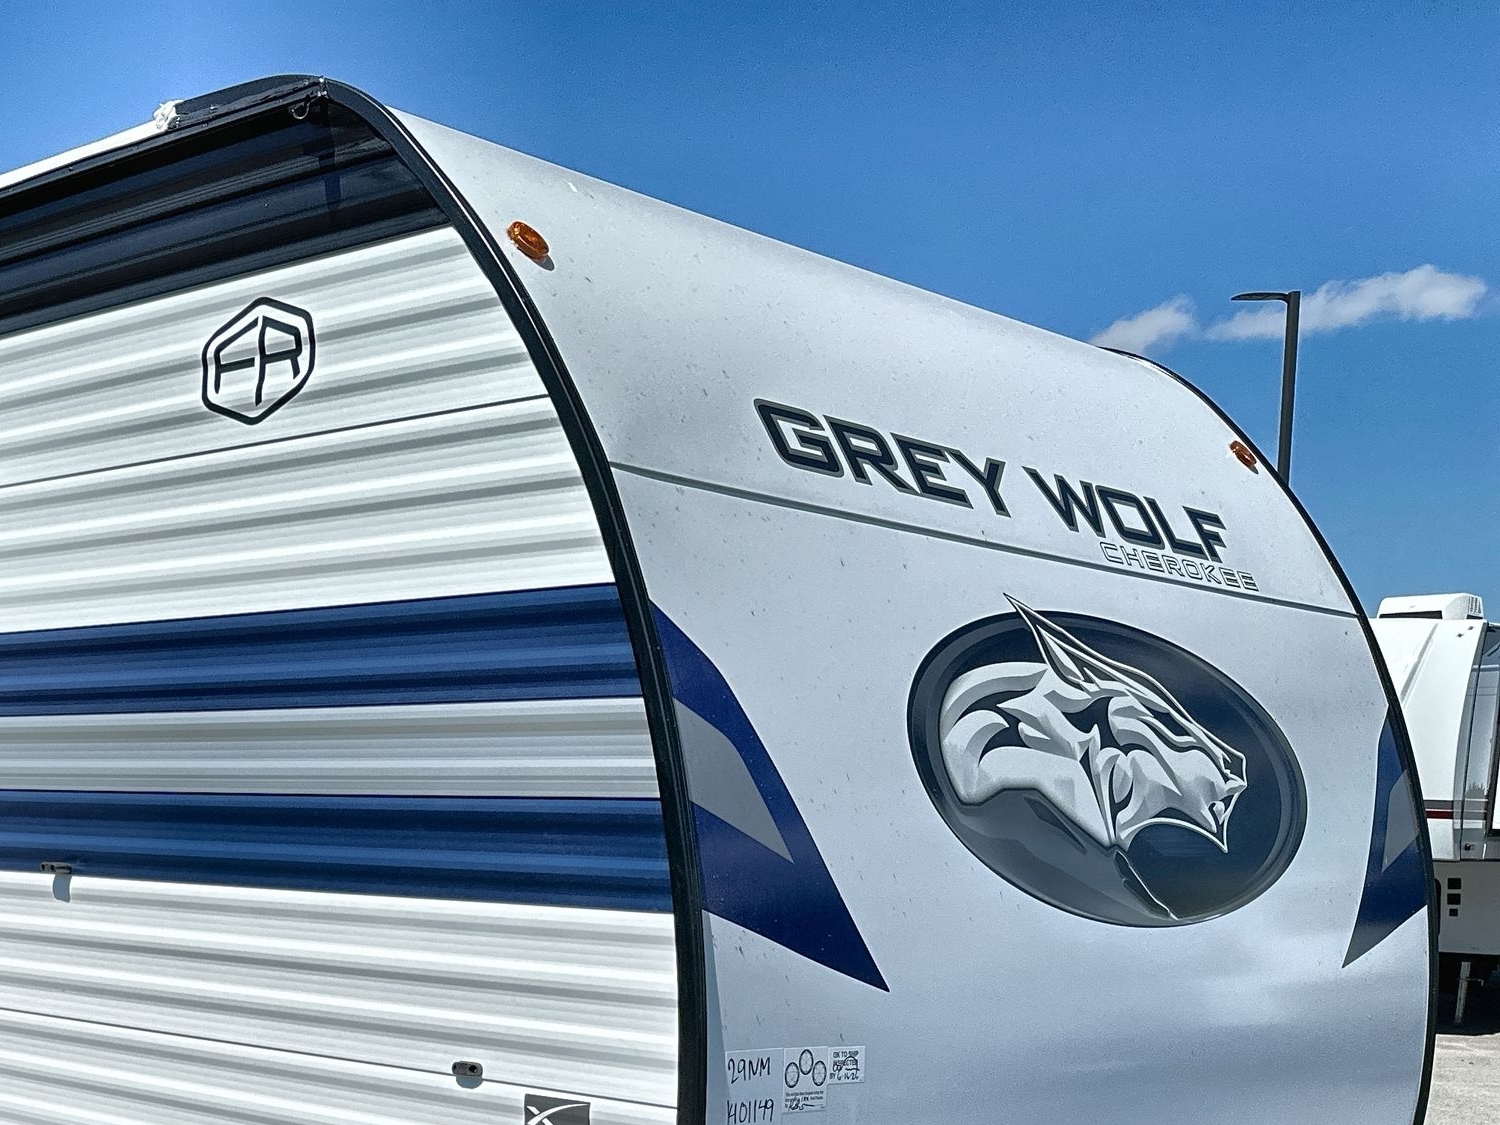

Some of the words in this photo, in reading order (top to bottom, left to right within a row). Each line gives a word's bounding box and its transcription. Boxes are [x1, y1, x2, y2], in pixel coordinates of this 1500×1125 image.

[754, 399, 1010, 517] GREY
[1023, 465, 1228, 563] WOLF
[1100, 541, 1260, 592] CHEROKEE
[727, 1056, 771, 1085] 29NM
